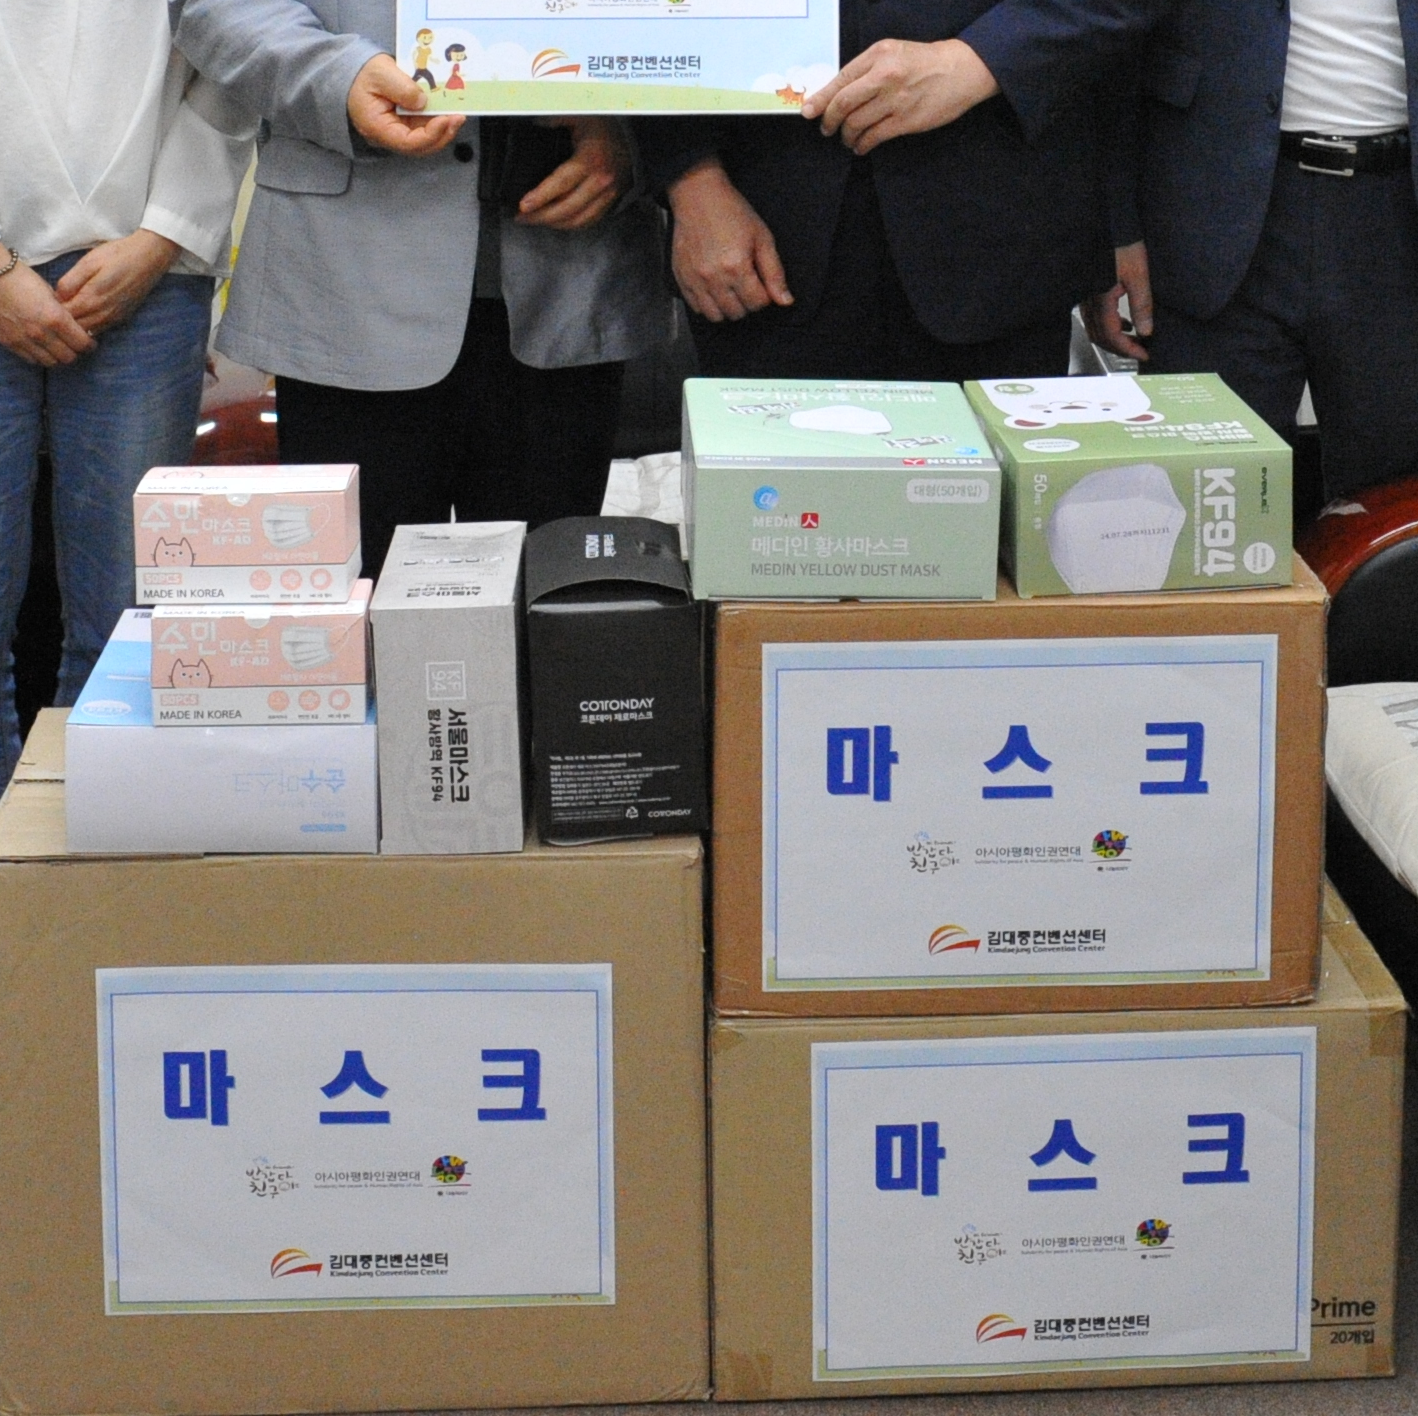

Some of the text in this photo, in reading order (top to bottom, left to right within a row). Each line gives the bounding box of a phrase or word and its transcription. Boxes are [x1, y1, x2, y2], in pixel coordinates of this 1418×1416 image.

[587, 55, 701, 71] 김대중컨벤션센터
[587, 71, 701, 80] Kimdaejung Convention Center
[914, 485, 982, 498] 대형(50개입)
[202, 517, 251, 533] 마스크
[1203, 468, 1236, 576] KF94
[751, 536, 910, 557] 메디인 황사마스크
[800, 563, 857, 576] YELLOW
[861, 563, 897, 576] DUST
[901, 564, 940, 577] MASK
[143, 588, 225, 598] MADE IN KOREA
[220, 639, 269, 654] 마스크
[447, 668, 461, 692] KF
[579, 697, 655, 712] COTTONDAY
[159, 709, 242, 720] MADE IN KOREA
[427, 708, 444, 802] 황사방역 KF94
[447, 708, 470, 803] 서울마스크
[648, 808, 692, 818] COTTONDAY
[975, 846, 1082, 857] 아시아평화인권연대
[987, 929, 1106, 946] 김대중컨벤션센터
[987, 945, 1106, 955] Kimdaejung Convention Center
[314, 1171, 421, 1182] 아시아평화인권연대
[1021, 1235, 1126, 1248] 아시아평화인권연대
[329, 1253, 449, 1269] 김대중컨벤션센터
[329, 1268, 449, 1278] Kimdaejung Convention Center
[1034, 1315, 1150, 1333] 김대중컨벤션센터
[1034, 1330, 1149, 1341] Kimdaejung Convention Center
[1329, 1329, 1375, 1344] 20개입
